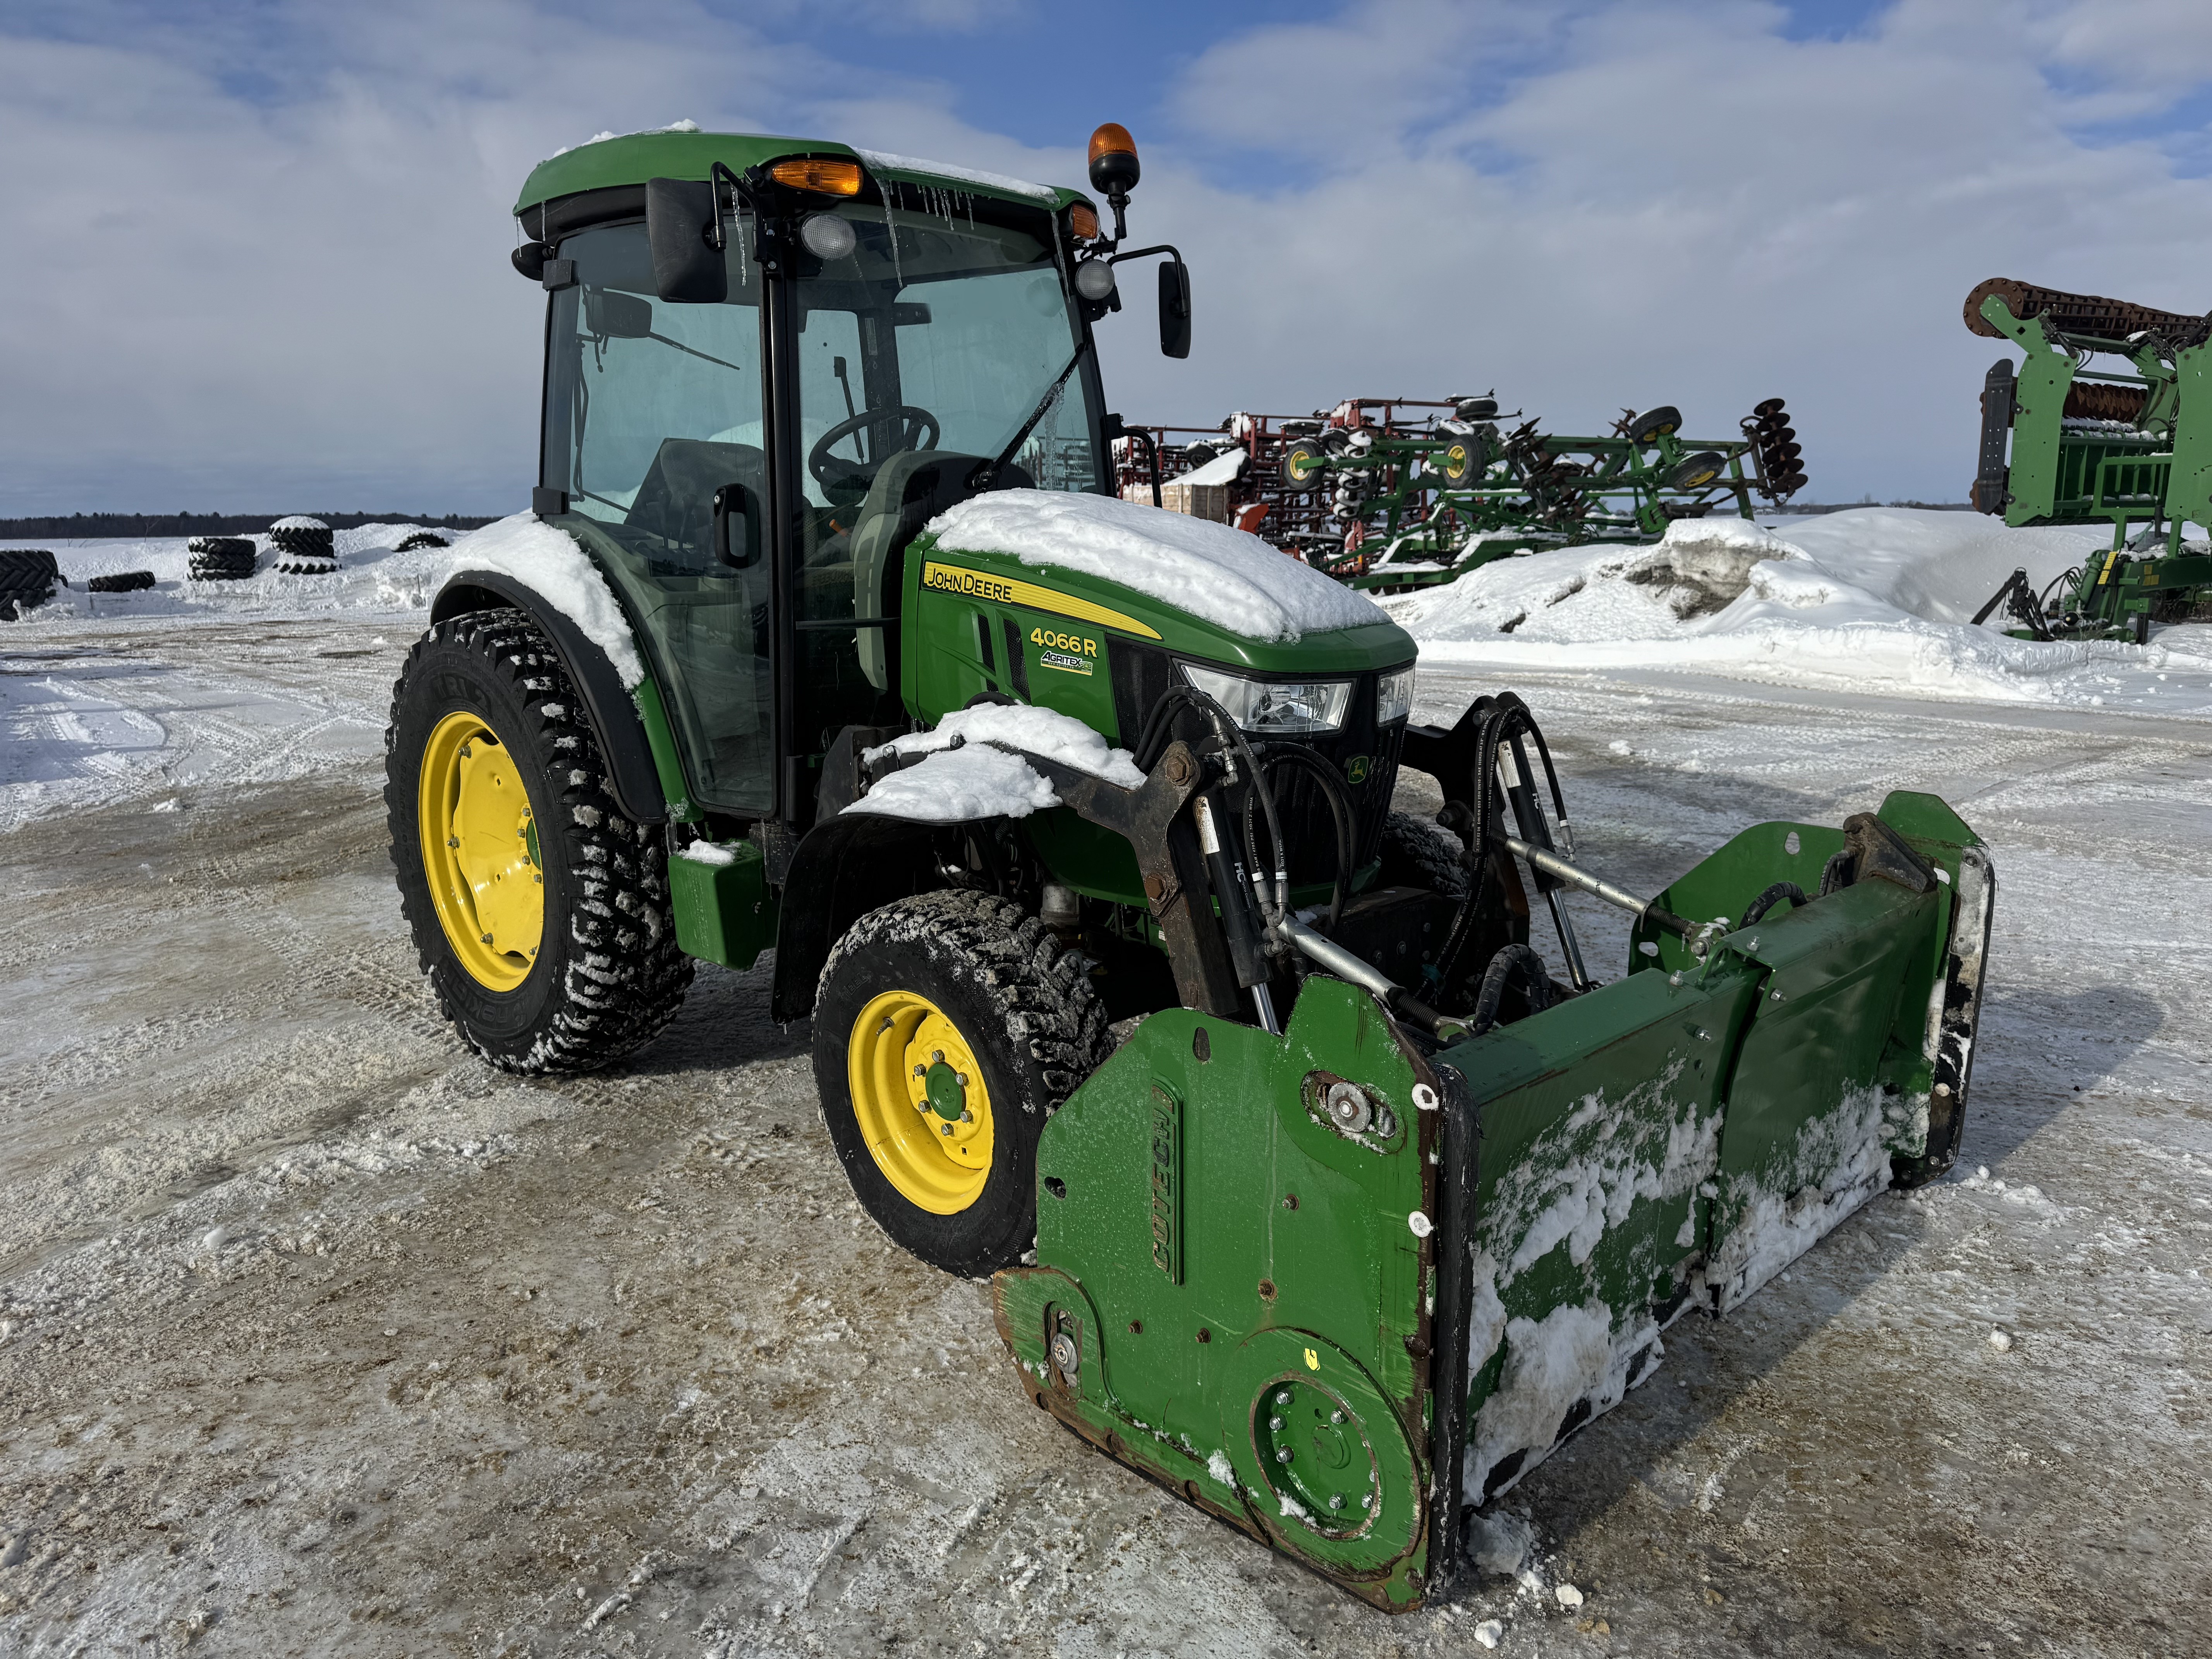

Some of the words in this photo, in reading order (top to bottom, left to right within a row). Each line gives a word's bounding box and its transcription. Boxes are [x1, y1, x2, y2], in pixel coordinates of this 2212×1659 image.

[928, 568, 962, 590] JOHN
[963, 574, 1012, 601] DEERE
[1042, 651, 1082, 667] AGRITEX
[1234, 862, 1246, 883] HC
[1152, 1106, 1170, 1273] COTECH
